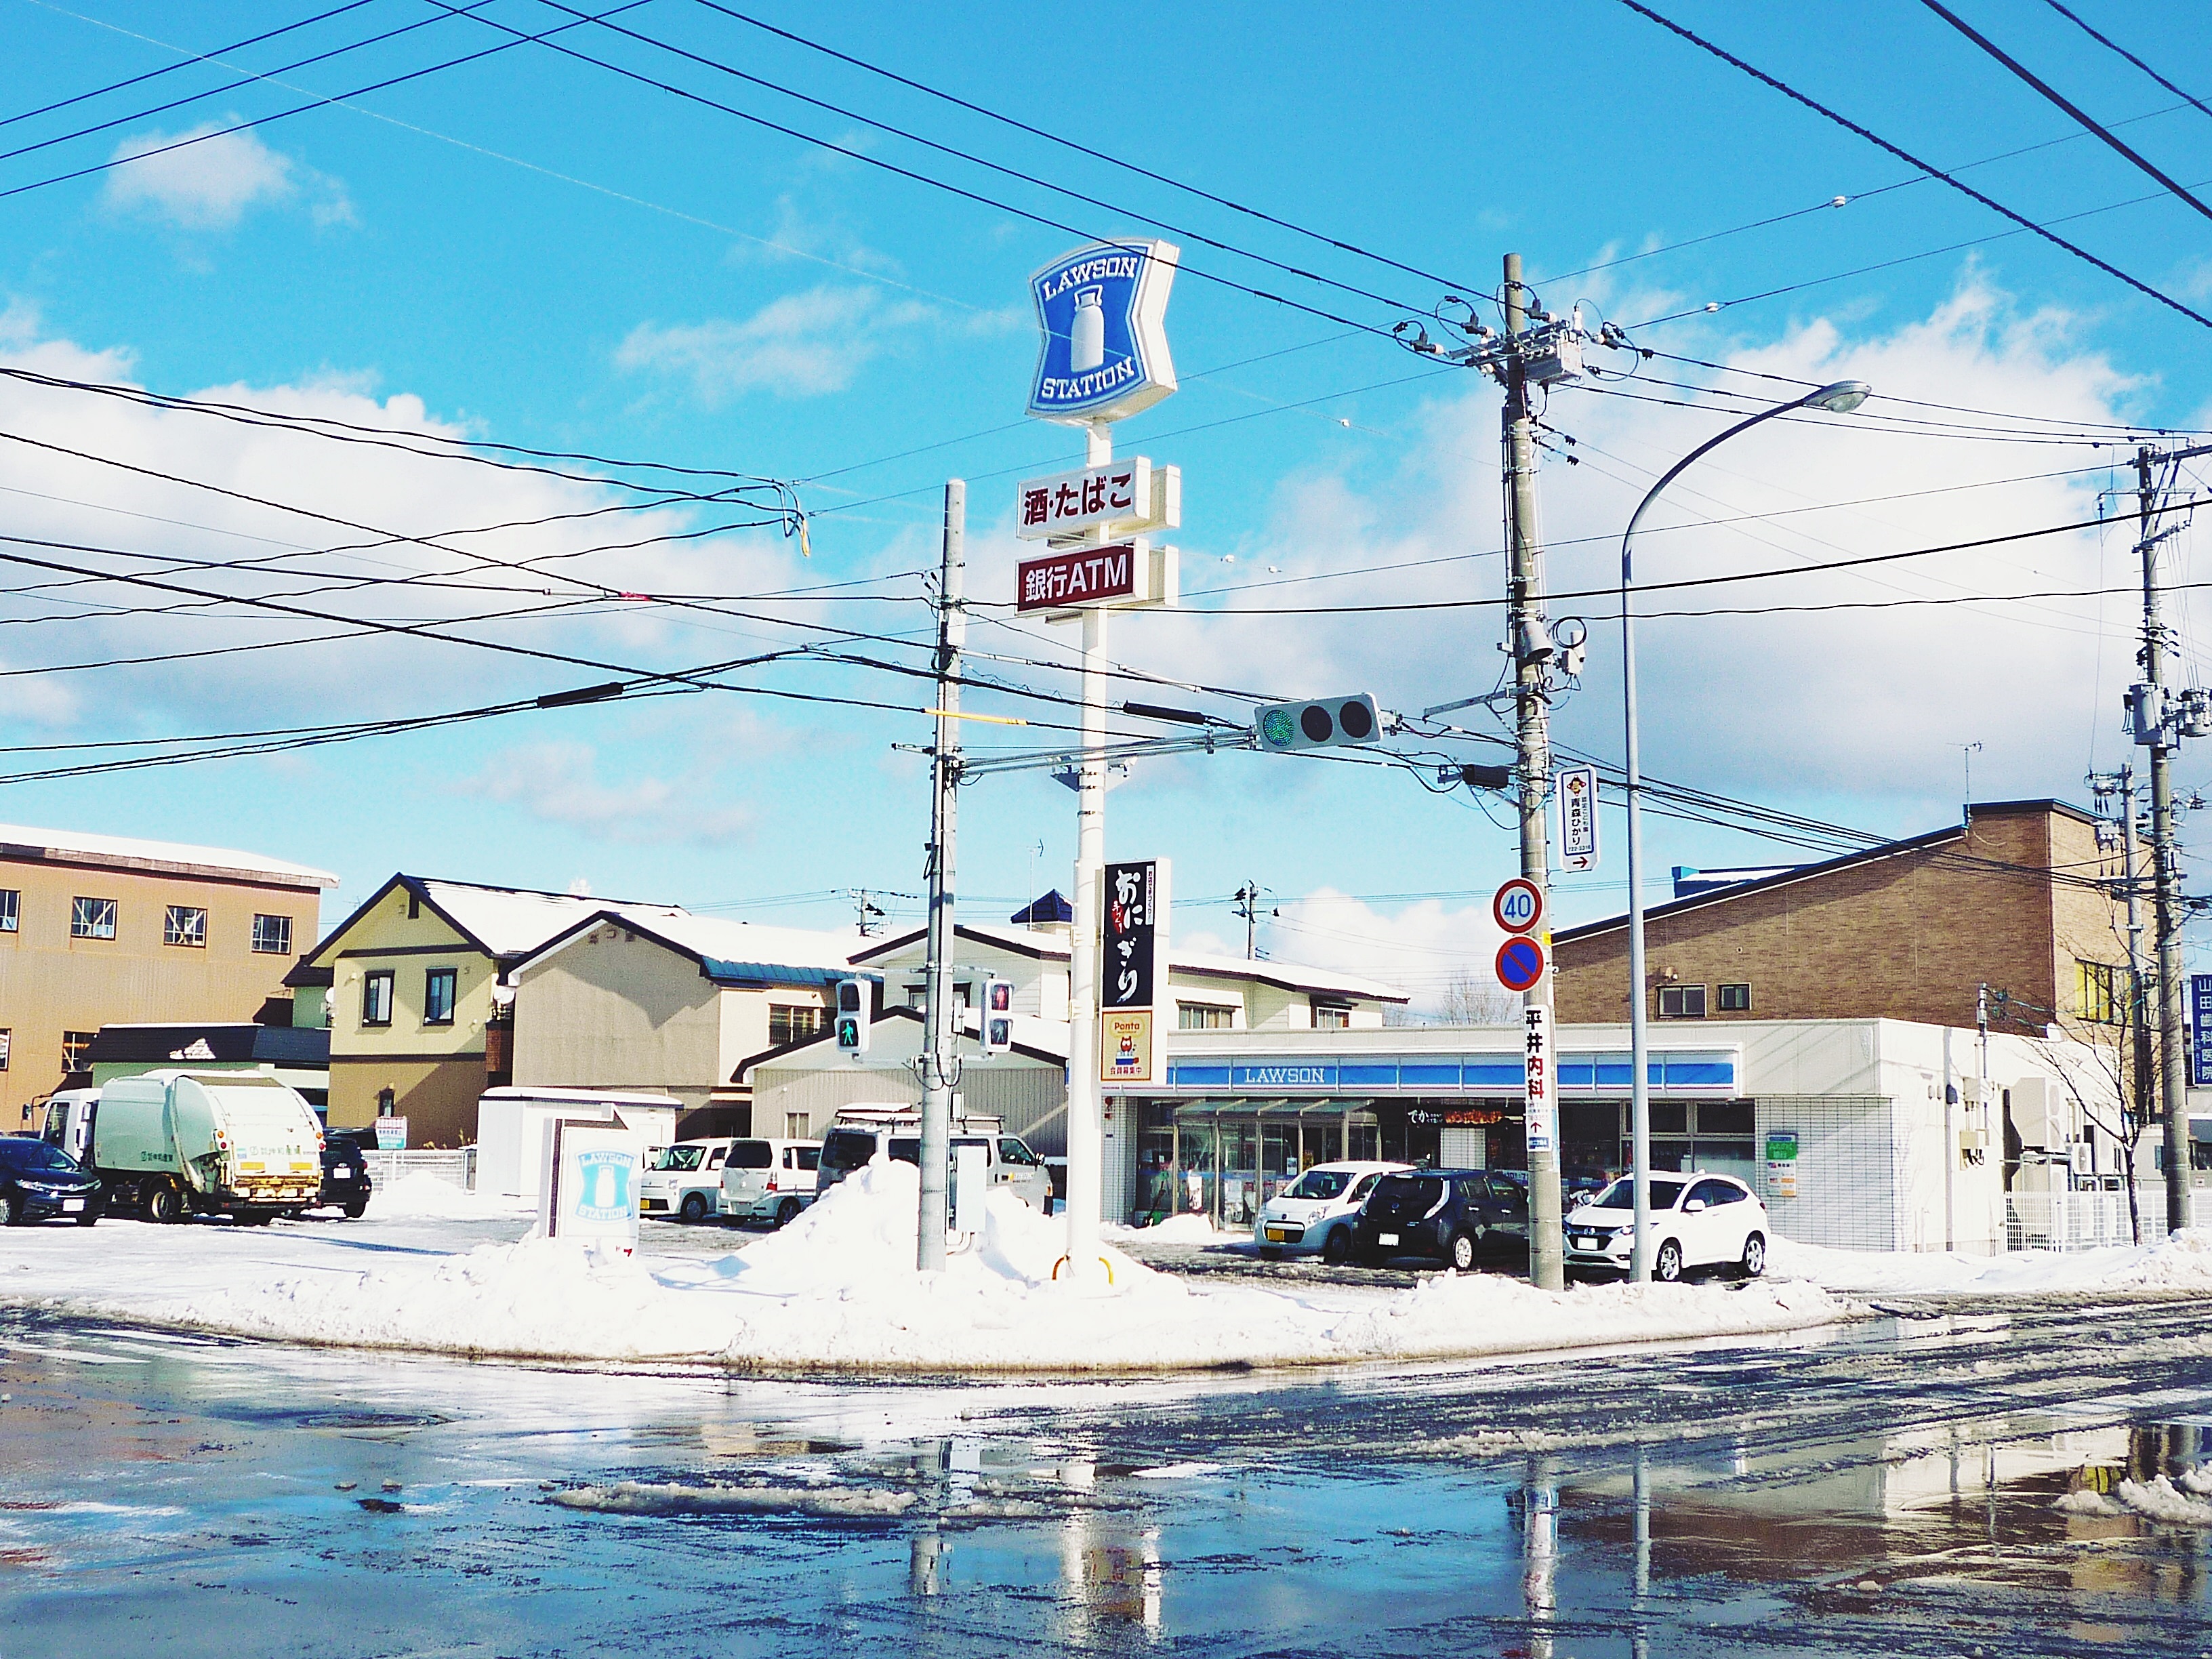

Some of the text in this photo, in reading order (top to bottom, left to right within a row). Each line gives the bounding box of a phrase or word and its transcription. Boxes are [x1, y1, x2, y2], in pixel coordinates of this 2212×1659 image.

[1042, 257, 1138, 302] LAWSON
[1042, 356, 1134, 398] STATION
[1023, 473, 1132, 525] 酒・たばこ
[1025, 554, 1126, 602] 銀行ATM
[1571, 798, 1581, 846] 青森ひかり
[1504, 894, 1532, 918] 40
[1115, 869, 1143, 1003] おにぎり
[1114, 1022, 1140, 1030] Ponta
[2199, 978, 2212, 1080] 山田歯科医院
[1244, 1068, 1325, 1083] LAWSON
[1526, 1010, 1544, 1100] 平井内科
[581, 1152, 632, 1168] LAWSON
[578, 1206, 628, 1220] STATION
